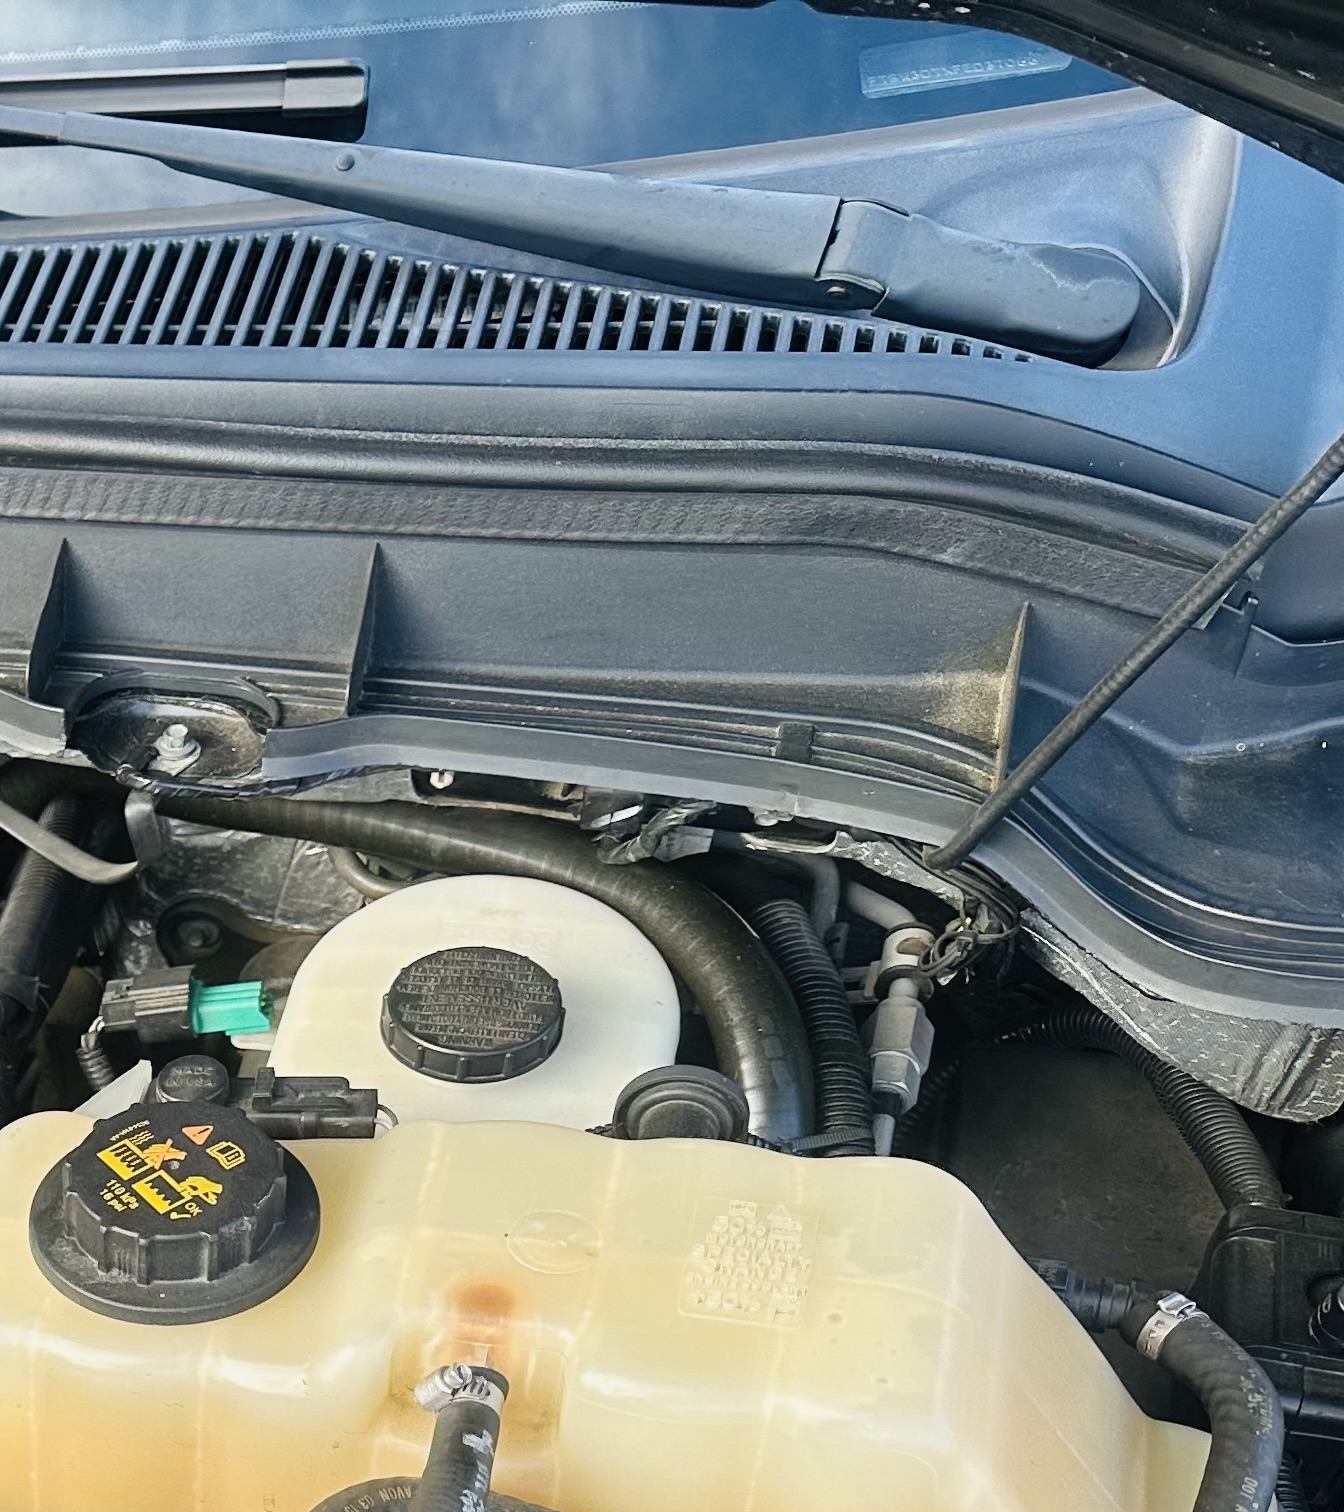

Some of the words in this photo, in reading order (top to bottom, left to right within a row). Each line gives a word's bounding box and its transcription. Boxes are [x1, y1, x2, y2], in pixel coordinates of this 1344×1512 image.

[99, 1188, 115, 1202] 16
[107, 1197, 128, 1213] psi
[104, 1179, 127, 1199] 110
[119, 1191, 140, 1211] kPa
[184, 1202, 204, 1217] OK
[379, 1485, 412, 1504] AVON
[1241, 1476, 1259, 1502] DOT
[361, 1494, 376, 1511] 03
